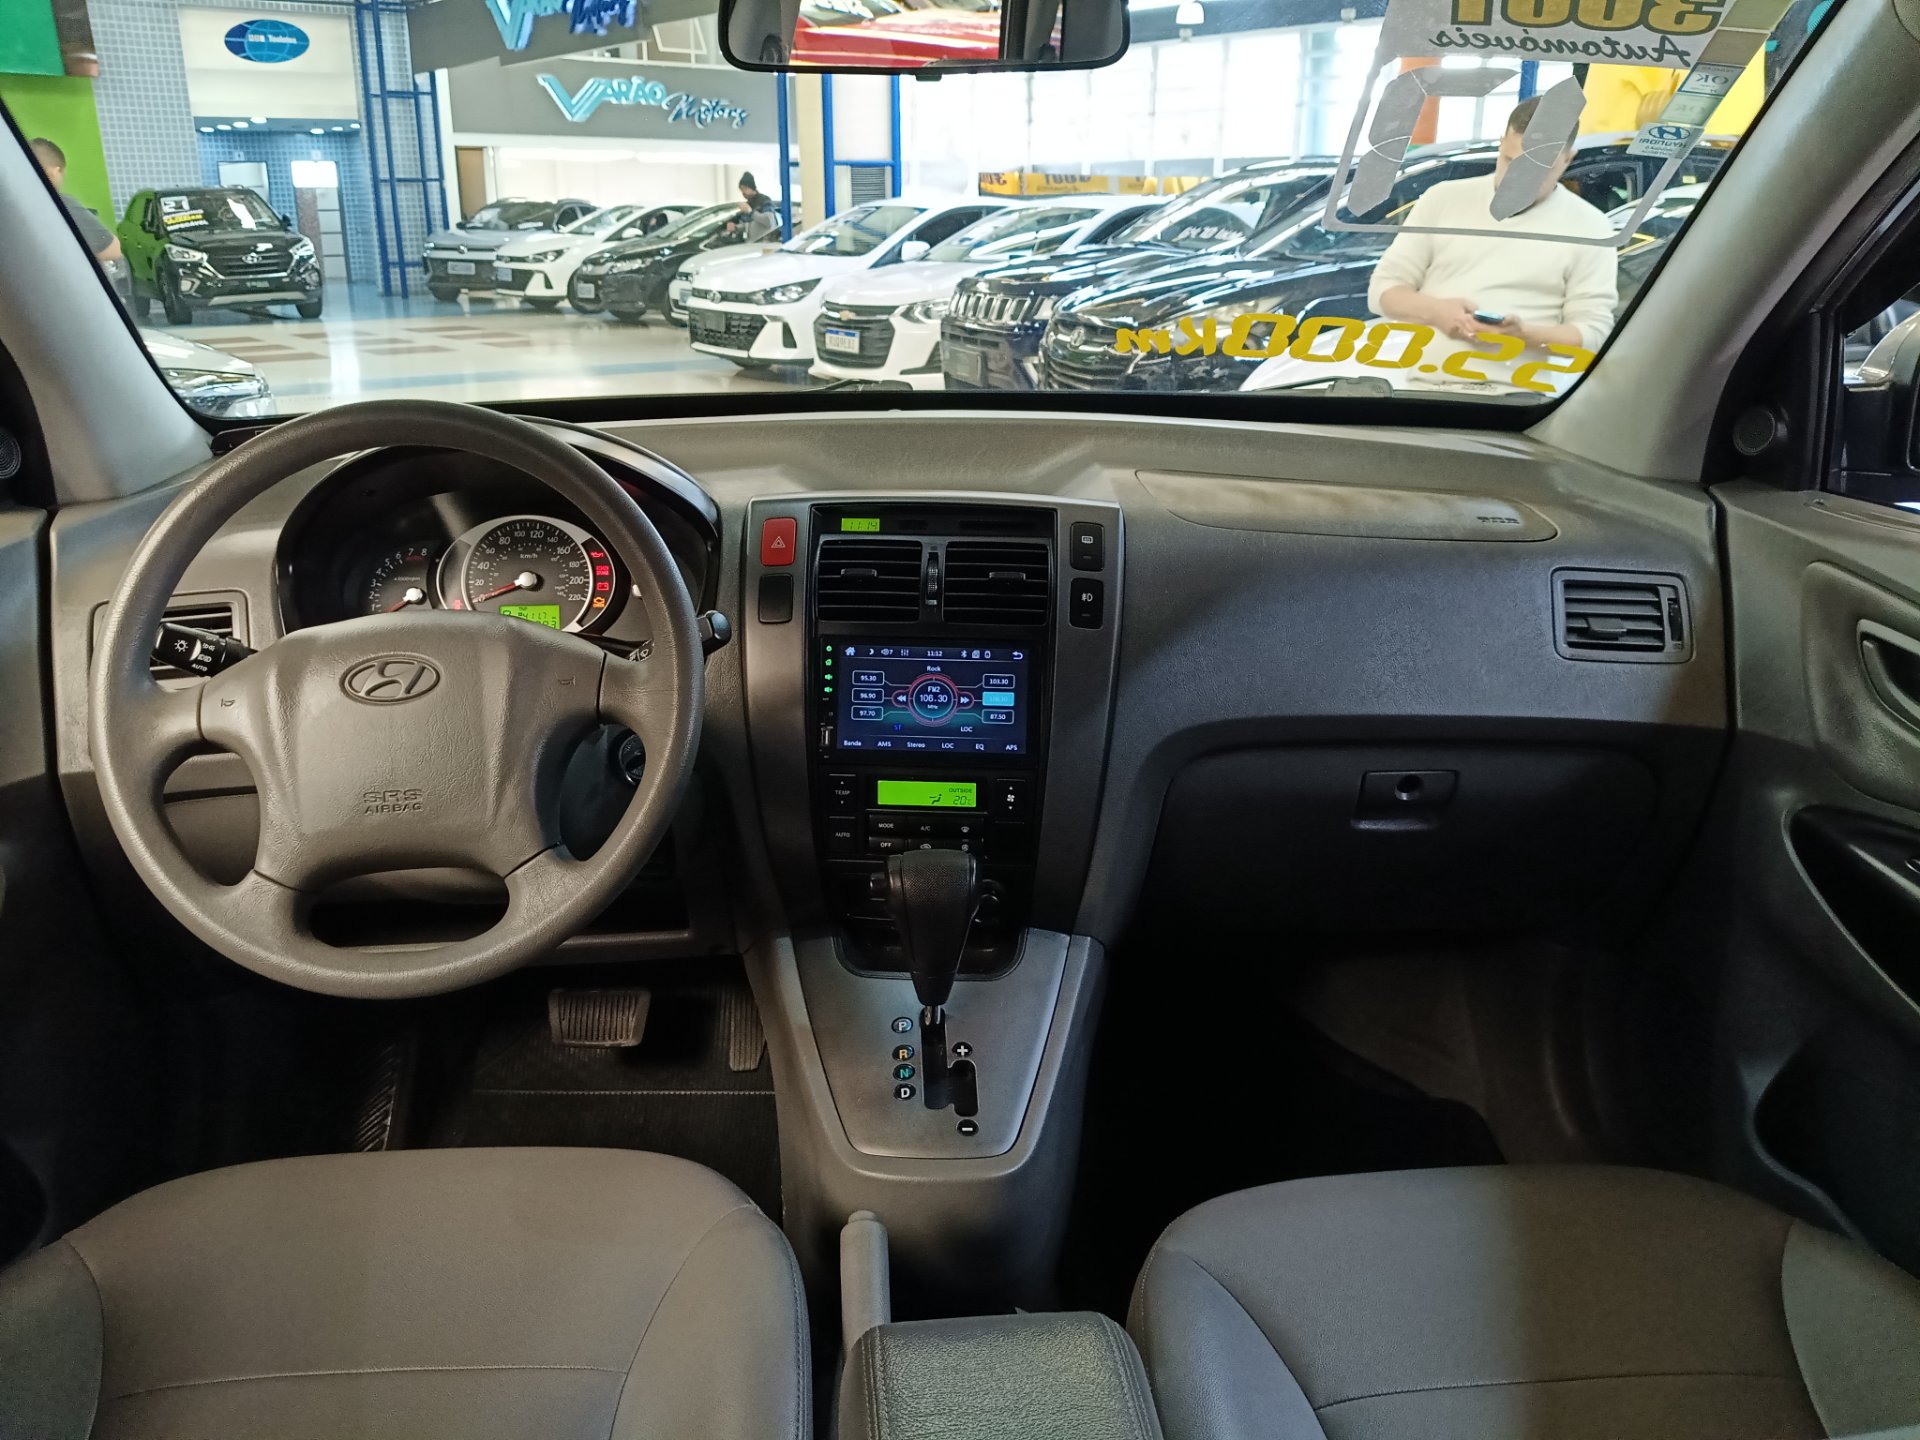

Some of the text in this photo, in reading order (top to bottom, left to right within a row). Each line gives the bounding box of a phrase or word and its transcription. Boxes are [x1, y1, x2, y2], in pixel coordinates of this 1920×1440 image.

[530, 530, 544, 538] 120
[498, 536, 511, 544] 80
[557, 546, 570, 554] 160
[477, 561, 489, 570] 40
[475, 578, 484, 586] 20
[569, 576, 584, 584] 200
[568, 593, 581, 601] 220
[192, 663, 208, 672] AUTO
[919, 694, 948, 703] 106.30
[975, 743, 985, 751] EQ
[363, 788, 422, 803] SRS
[364, 803, 422, 814] AIRBAG
[898, 1021, 907, 1031] P
[899, 1049, 908, 1059] R
[900, 1068, 909, 1079] N
[900, 1087, 911, 1098] D
